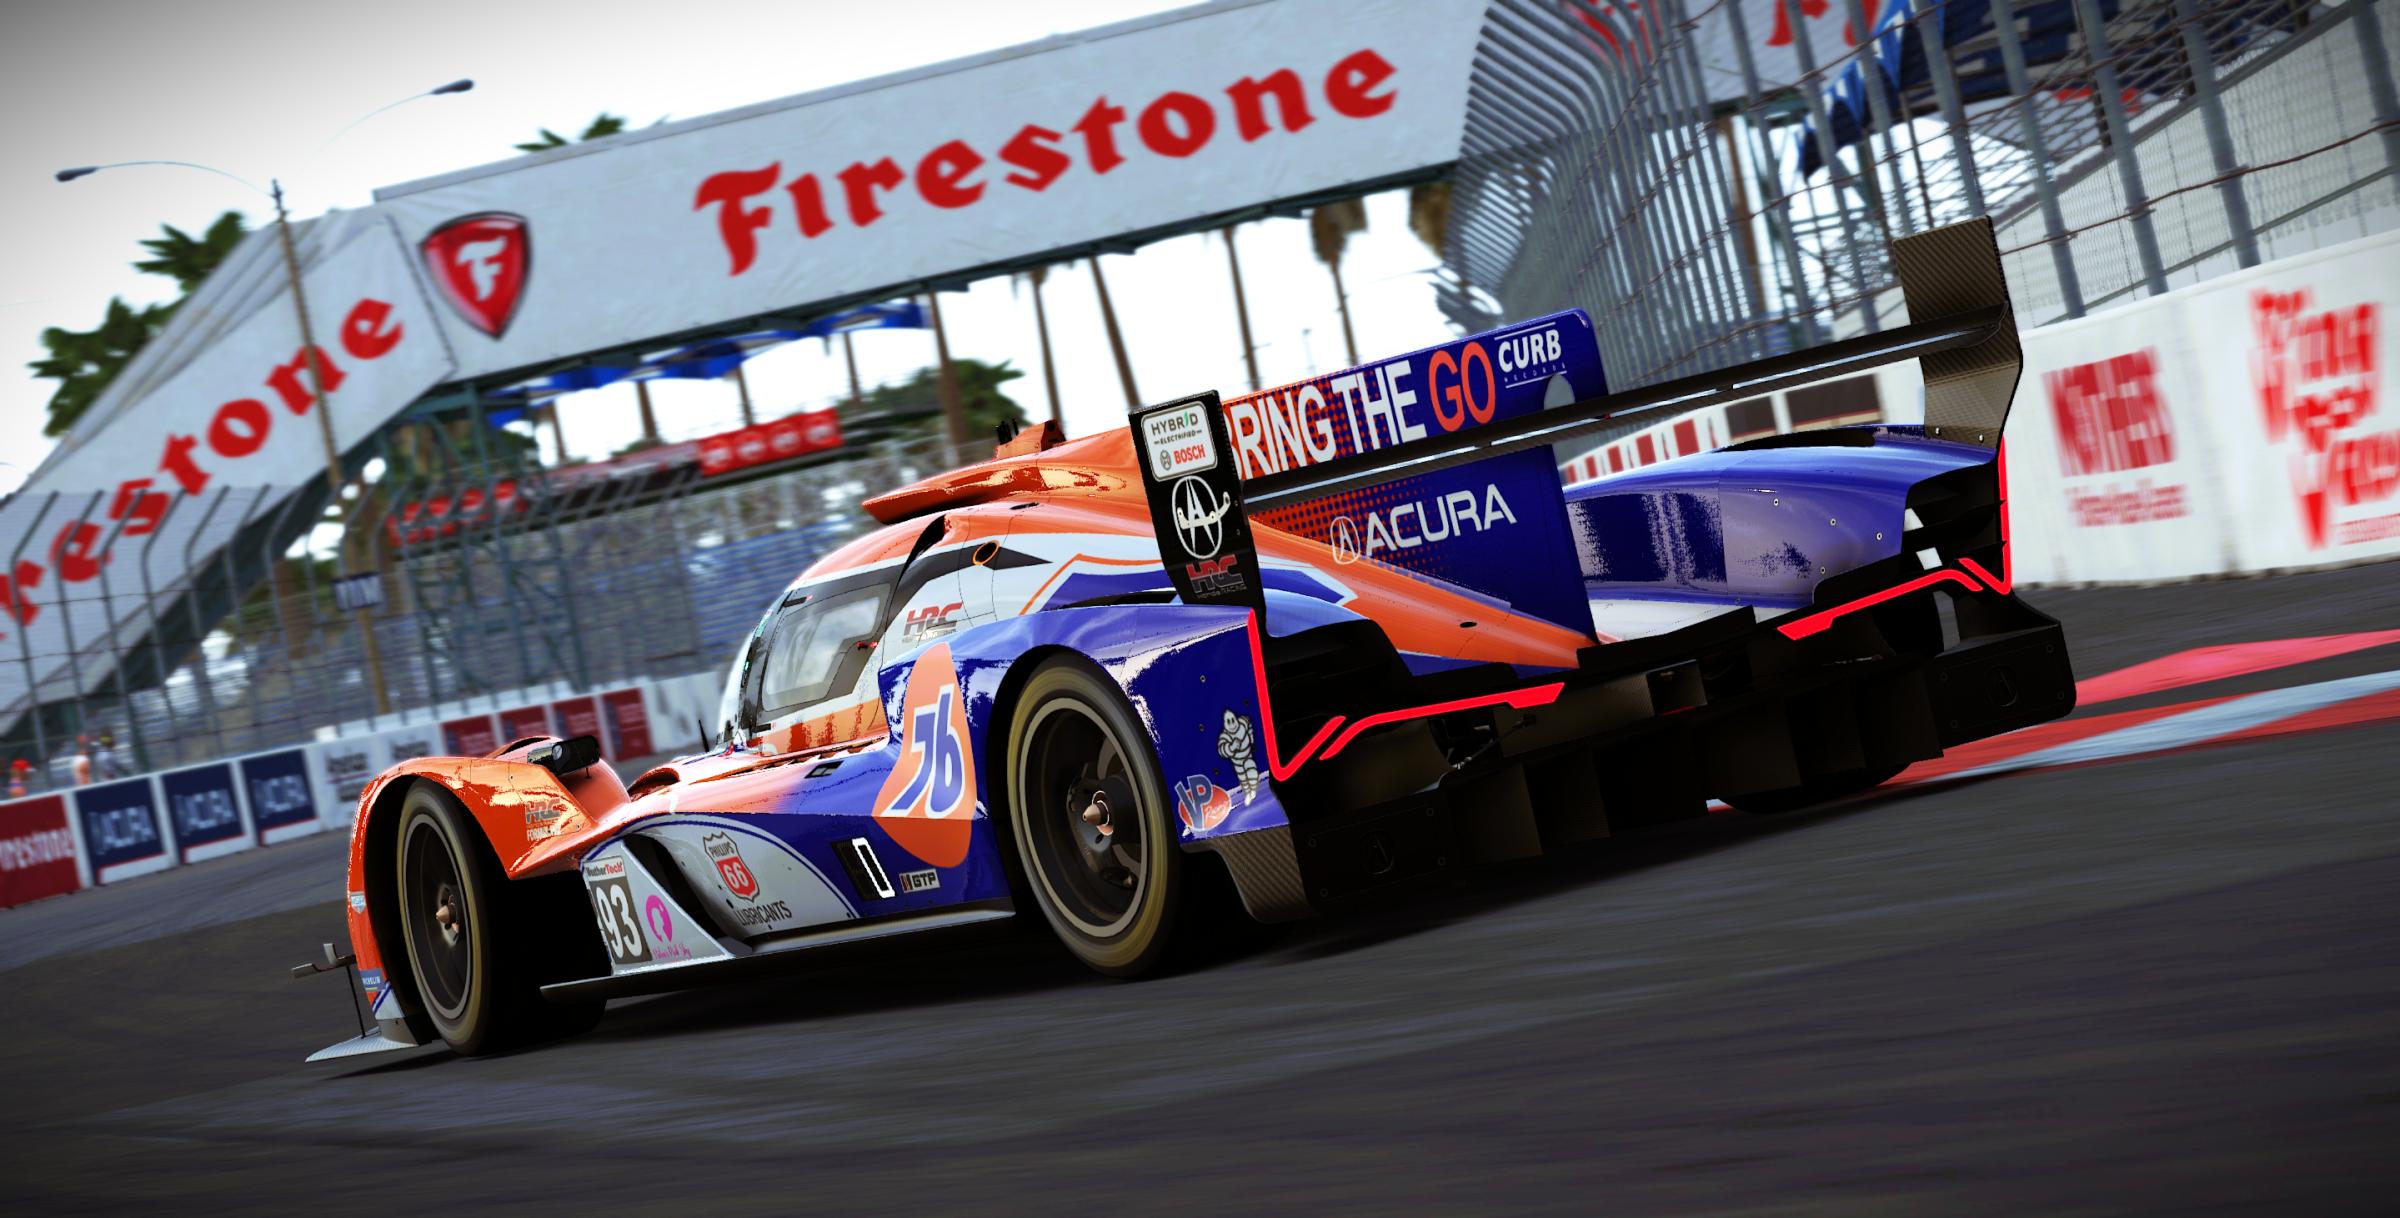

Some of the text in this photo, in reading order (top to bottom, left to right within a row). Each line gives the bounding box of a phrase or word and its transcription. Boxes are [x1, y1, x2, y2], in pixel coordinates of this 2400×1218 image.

[692, 47, 1398, 277] Firestone
[1498, 329, 1562, 373] CURB
[1331, 360, 1427, 454] THE
[1428, 341, 1496, 432] GO
[1150, 411, 1198, 435] HYBRID
[1160, 431, 1197, 445] ELECTRIFIED
[0, 297, 404, 638] restone
[1173, 444, 1206, 464] BOSCH
[1366, 483, 1518, 557] ACURA
[1186, 554, 1245, 593] HRC
[903, 601, 963, 636] HRC
[880, 683, 966, 820] 76
[1174, 774, 1213, 832] VP
[709, 841, 735, 858] PHILLIPS
[586, 862, 623, 877] WeatherTech
[723, 862, 749, 889] 66
[911, 871, 936, 887] GTP
[596, 884, 642, 959] 93
[734, 900, 793, 926] LUBRICANTS
